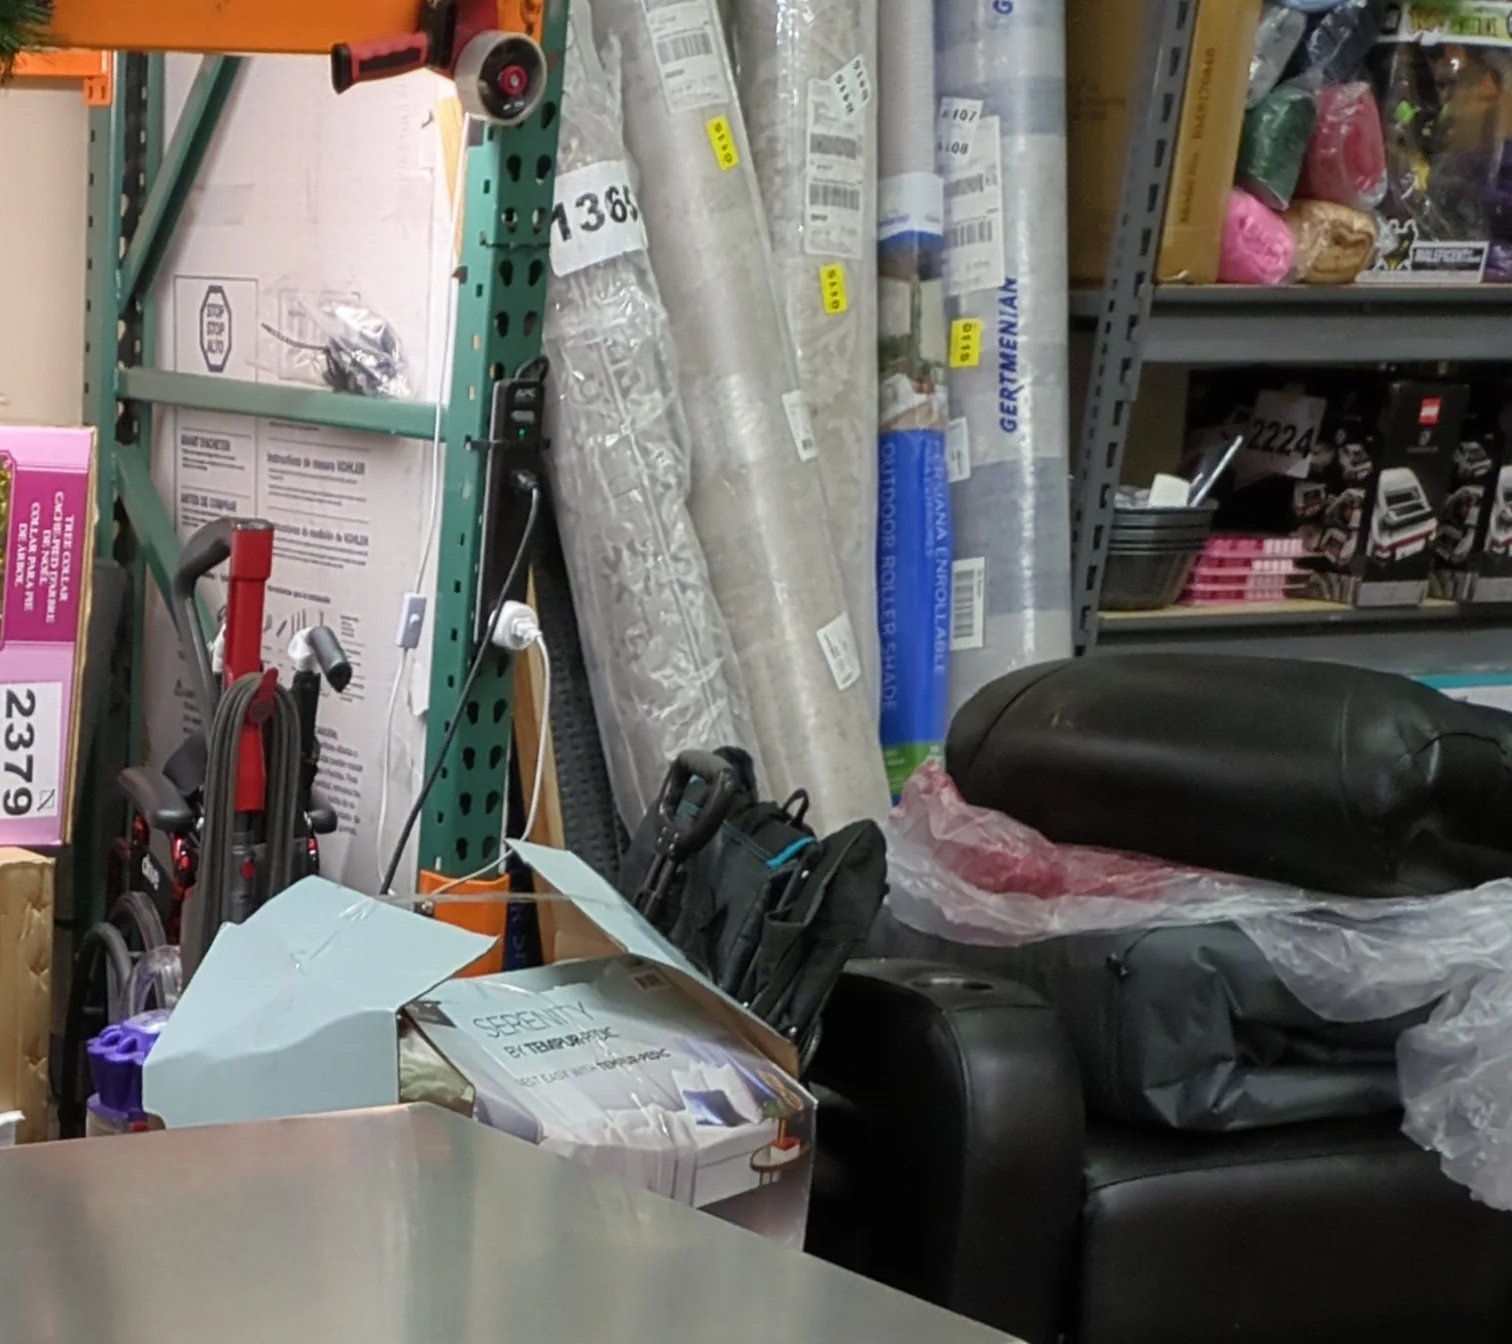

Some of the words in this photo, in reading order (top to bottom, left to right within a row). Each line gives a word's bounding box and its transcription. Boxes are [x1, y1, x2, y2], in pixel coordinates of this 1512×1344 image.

[998, 277, 1021, 433] GERTMENIAN
[1248, 420, 1315, 459] 2224
[880, 442, 897, 549] OUTDOOR
[18, 523, 28, 542] DE
[28, 502, 41, 553] COLLAR
[42, 529, 52, 549] DE
[63, 514, 75, 550] TREE
[25, 556, 37, 589] PARA
[59, 551, 71, 602] COLLAR
[24, 590, 35, 611] PIE
[881, 555, 897, 635] ROLLER
[2, 688, 36, 816] 2379
[473, 1001, 594, 1038] SERENITY
[504, 1044, 527, 1059] BY
